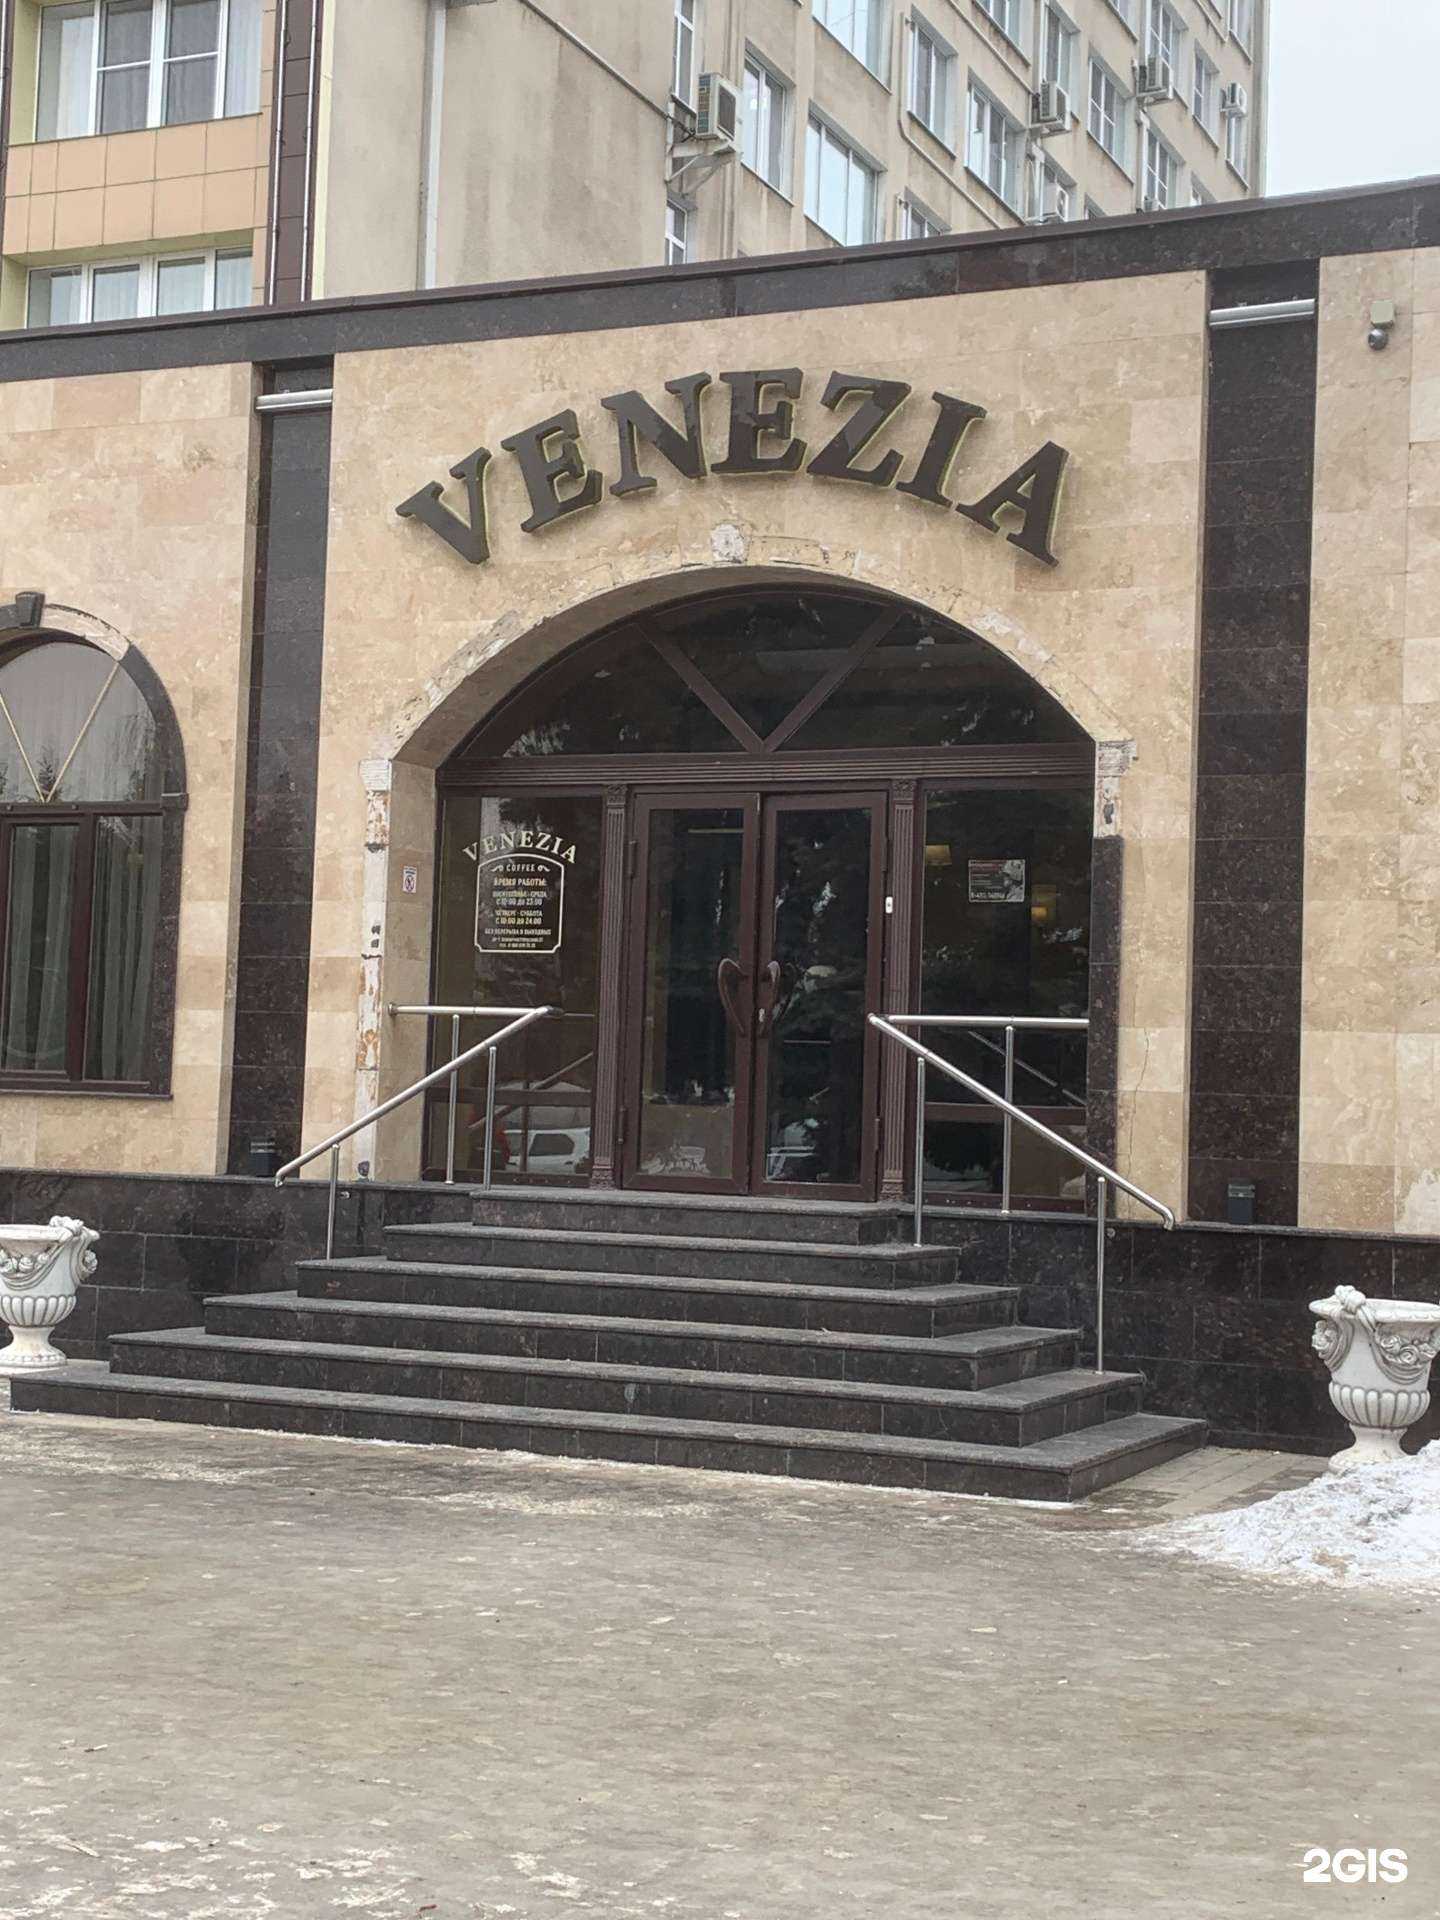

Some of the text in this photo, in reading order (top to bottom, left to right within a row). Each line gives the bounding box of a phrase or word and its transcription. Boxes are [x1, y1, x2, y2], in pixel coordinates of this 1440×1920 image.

[396, 367, 1070, 567] VENEZIA
[462, 830, 576, 864] VENEZIA
[506, 864, 535, 872] COFFEE
[494, 877, 517, 886] ВРЕМЯ
